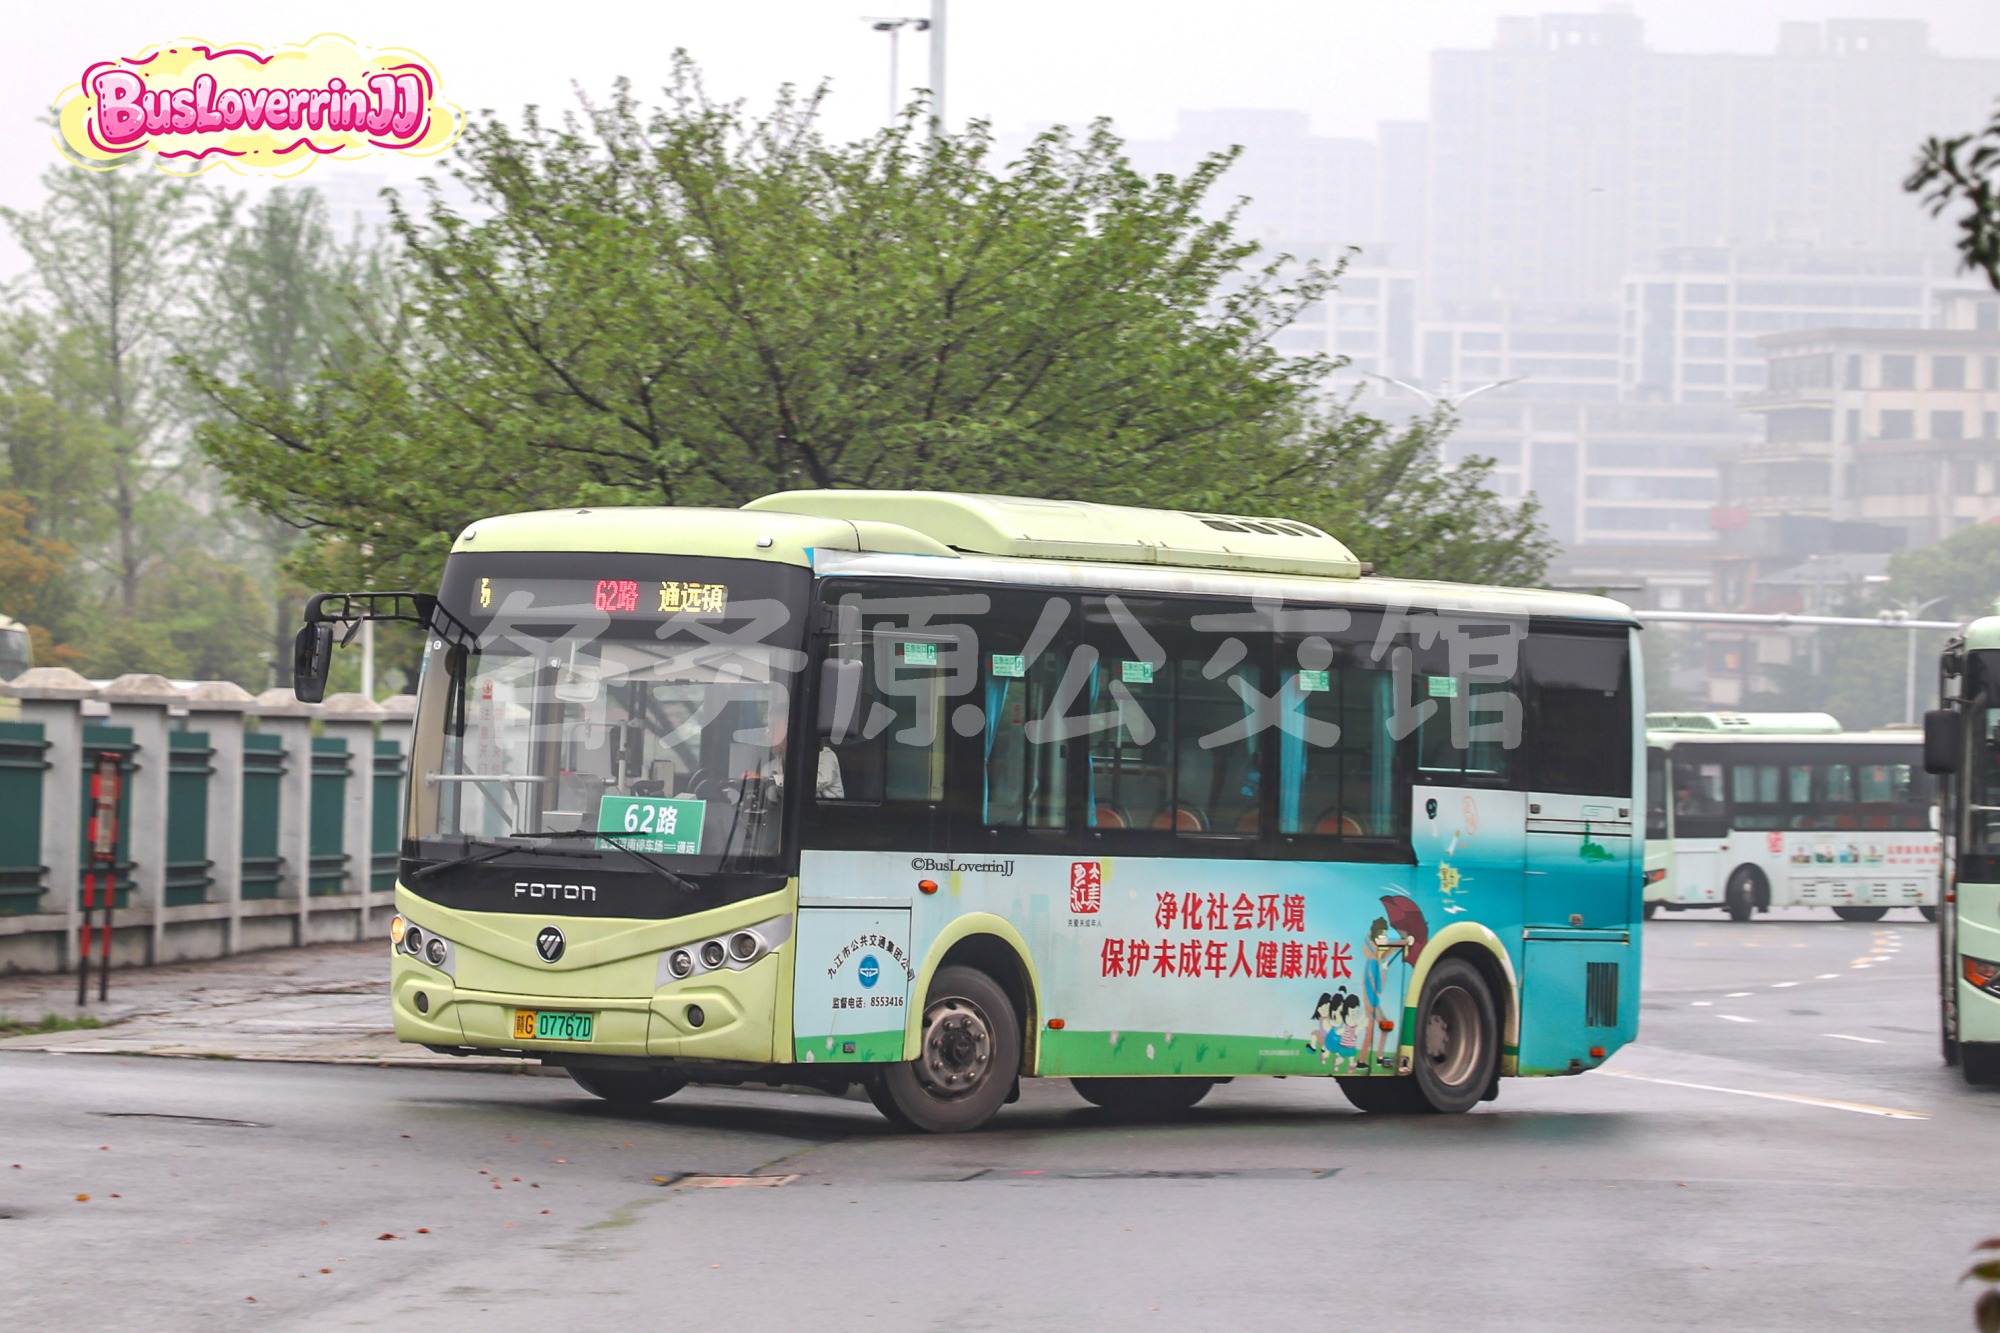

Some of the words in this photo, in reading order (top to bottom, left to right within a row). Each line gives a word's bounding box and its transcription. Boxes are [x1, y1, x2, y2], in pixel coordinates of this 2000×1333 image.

[594, 580, 639, 611] 62路
[657, 581, 725, 613] 通远镇
[624, 804, 678, 835] 62路
[514, 882, 596, 902] FOTON
[1154, 891, 1306, 933] 净化社会环境
[827, 934, 916, 982] 九江市公共交通集团公司
[1101, 938, 1353, 980] 保护未成年人健康成长
